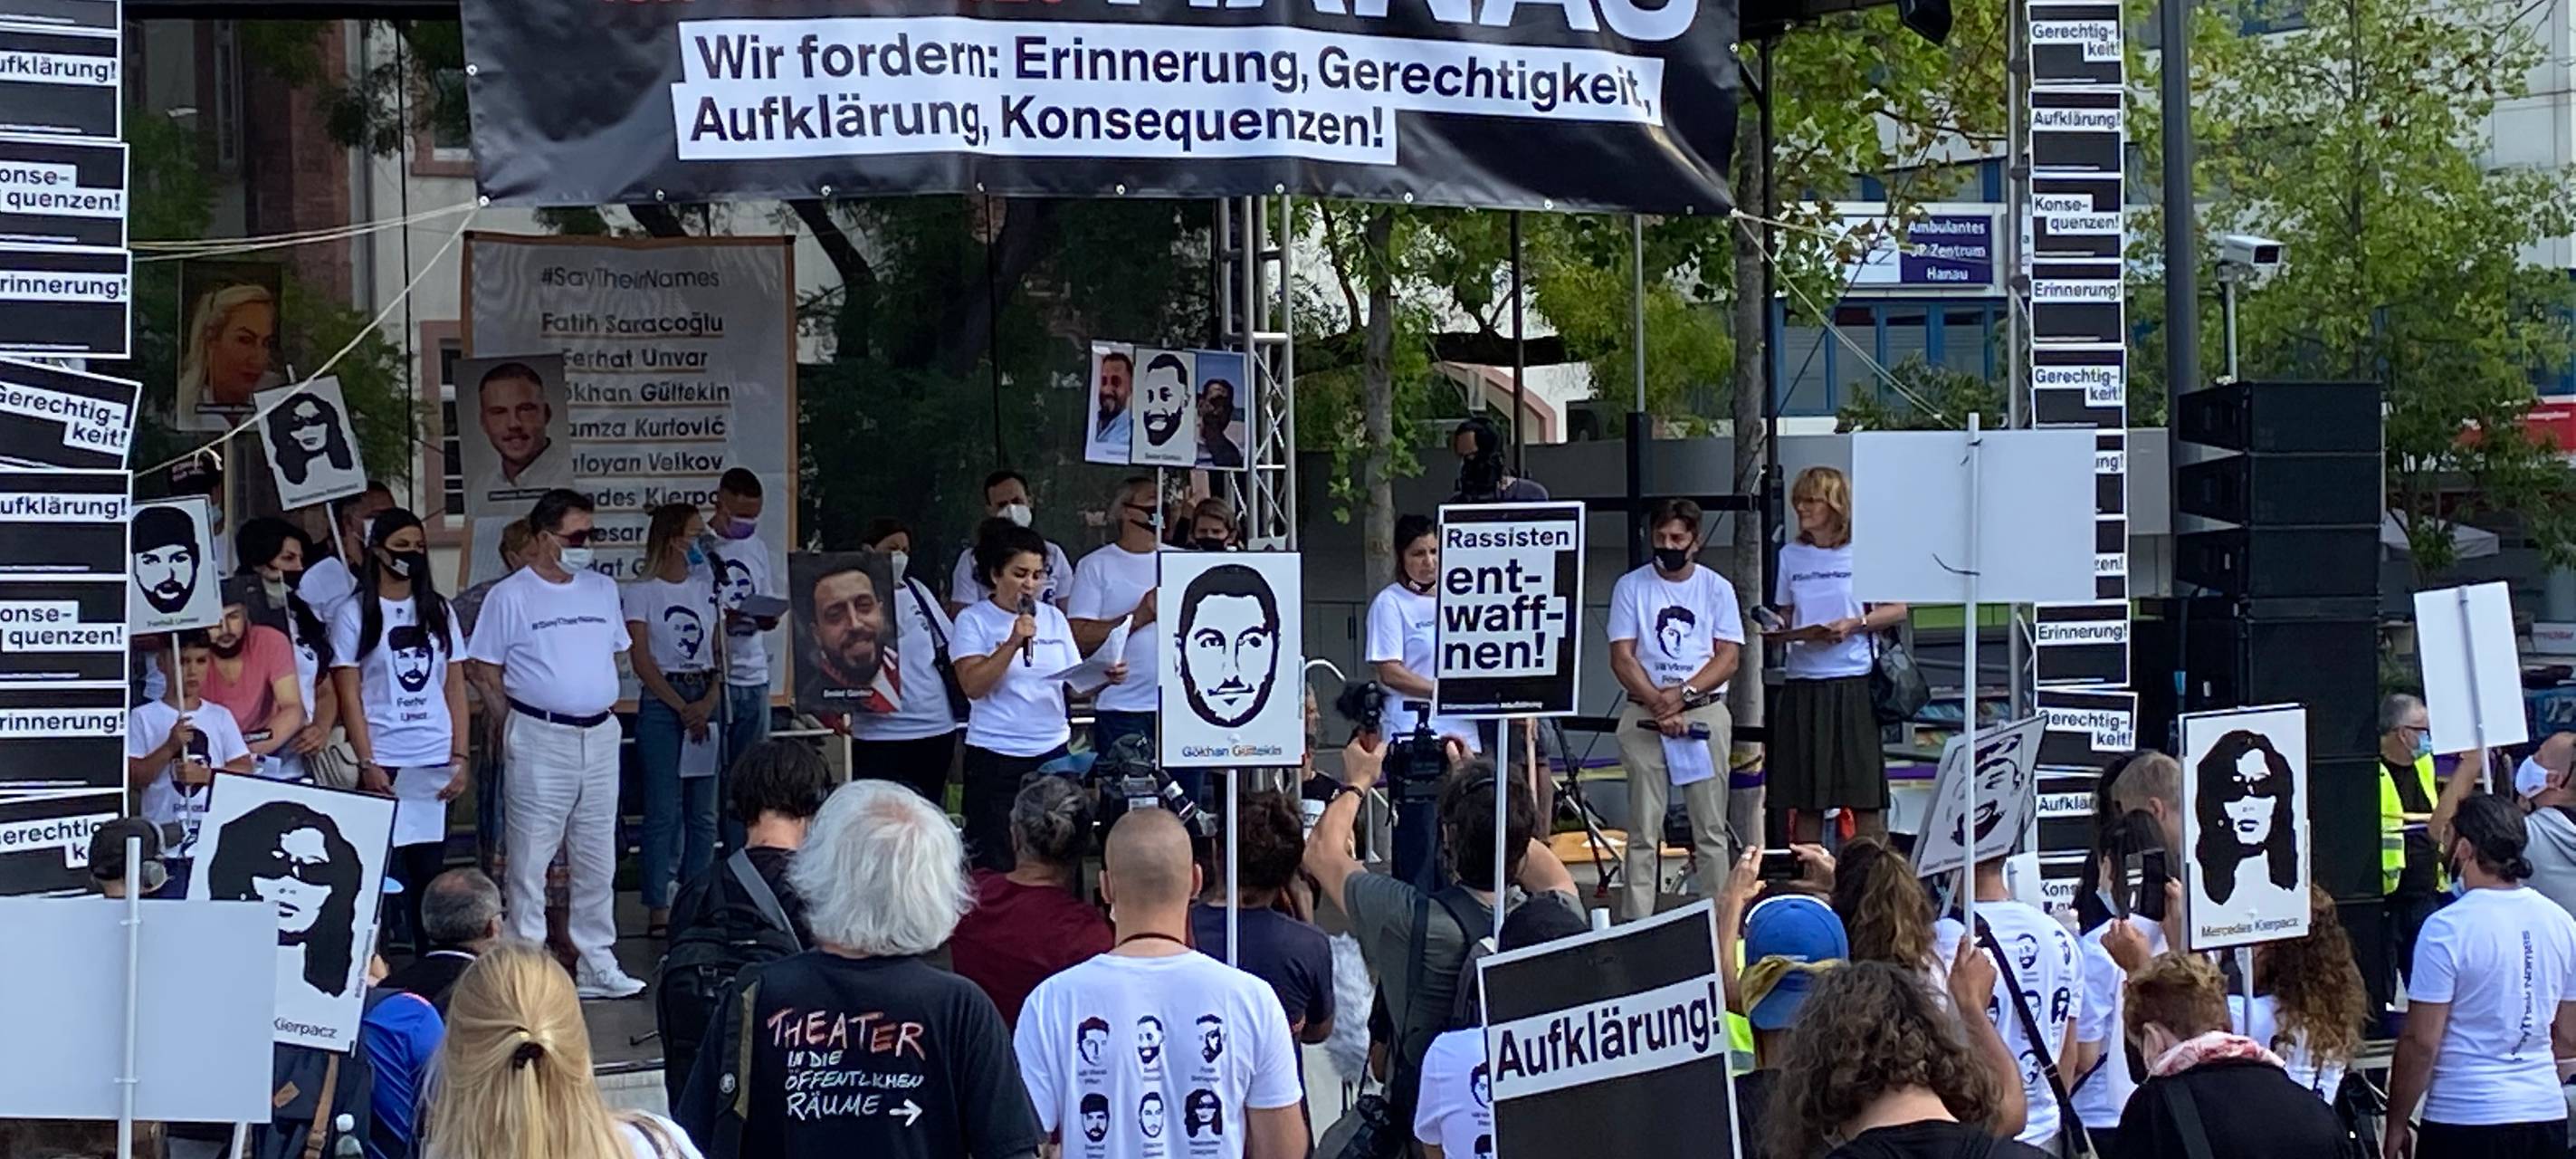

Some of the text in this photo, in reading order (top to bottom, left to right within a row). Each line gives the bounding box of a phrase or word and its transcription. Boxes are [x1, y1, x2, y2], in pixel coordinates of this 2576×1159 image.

[2032, 24, 2114, 42] Gerechtig-
[2087, 41, 2120, 57] keit!
[695, 33, 1652, 115] Wir fordern: Erinnerung, Gerechtigkeit,
[689, 93, 1384, 153] Aufklärung, Konsequenzen!
[2034, 110, 2121, 129] Aufklärung!
[7, 191, 121, 212] quenzen!
[2035, 196, 2088, 212] Konse-
[1907, 220, 1985, 235] Ambulantes
[2050, 215, 2120, 232] quenzen!
[541, 266, 720, 290] #SayTheirNames
[1926, 266, 1969, 280] Hanau
[2034, 282, 2122, 300] Erinnerung!
[541, 312, 598, 333] Fatih
[561, 348, 709, 368] Ferhat Unvar
[2035, 368, 2118, 387] Gerechtig-
[640, 380, 730, 402] Gültekin
[2089, 382, 2123, 401] keit!
[72, 422, 128, 448] keit!
[634, 415, 726, 438] Kurtović
[647, 452, 723, 472] Velkov
[1446, 527, 1569, 549] Rassisten
[1445, 559, 1542, 595] ent-
[1444, 594, 1564, 632] waff-
[8, 626, 123, 649] quenzen!
[2038, 622, 2128, 641] Erinnerung!
[1444, 631, 1546, 670] nen!
[2096, 730, 2132, 747] keit!
[1182, 746, 1230, 758] Gökhan
[767, 1006, 926, 1061] THEATER
[1495, 981, 1721, 1083] Aufklärung!
[787, 1049, 844, 1068] IN DIE
[787, 1090, 883, 1122] RÄUME
